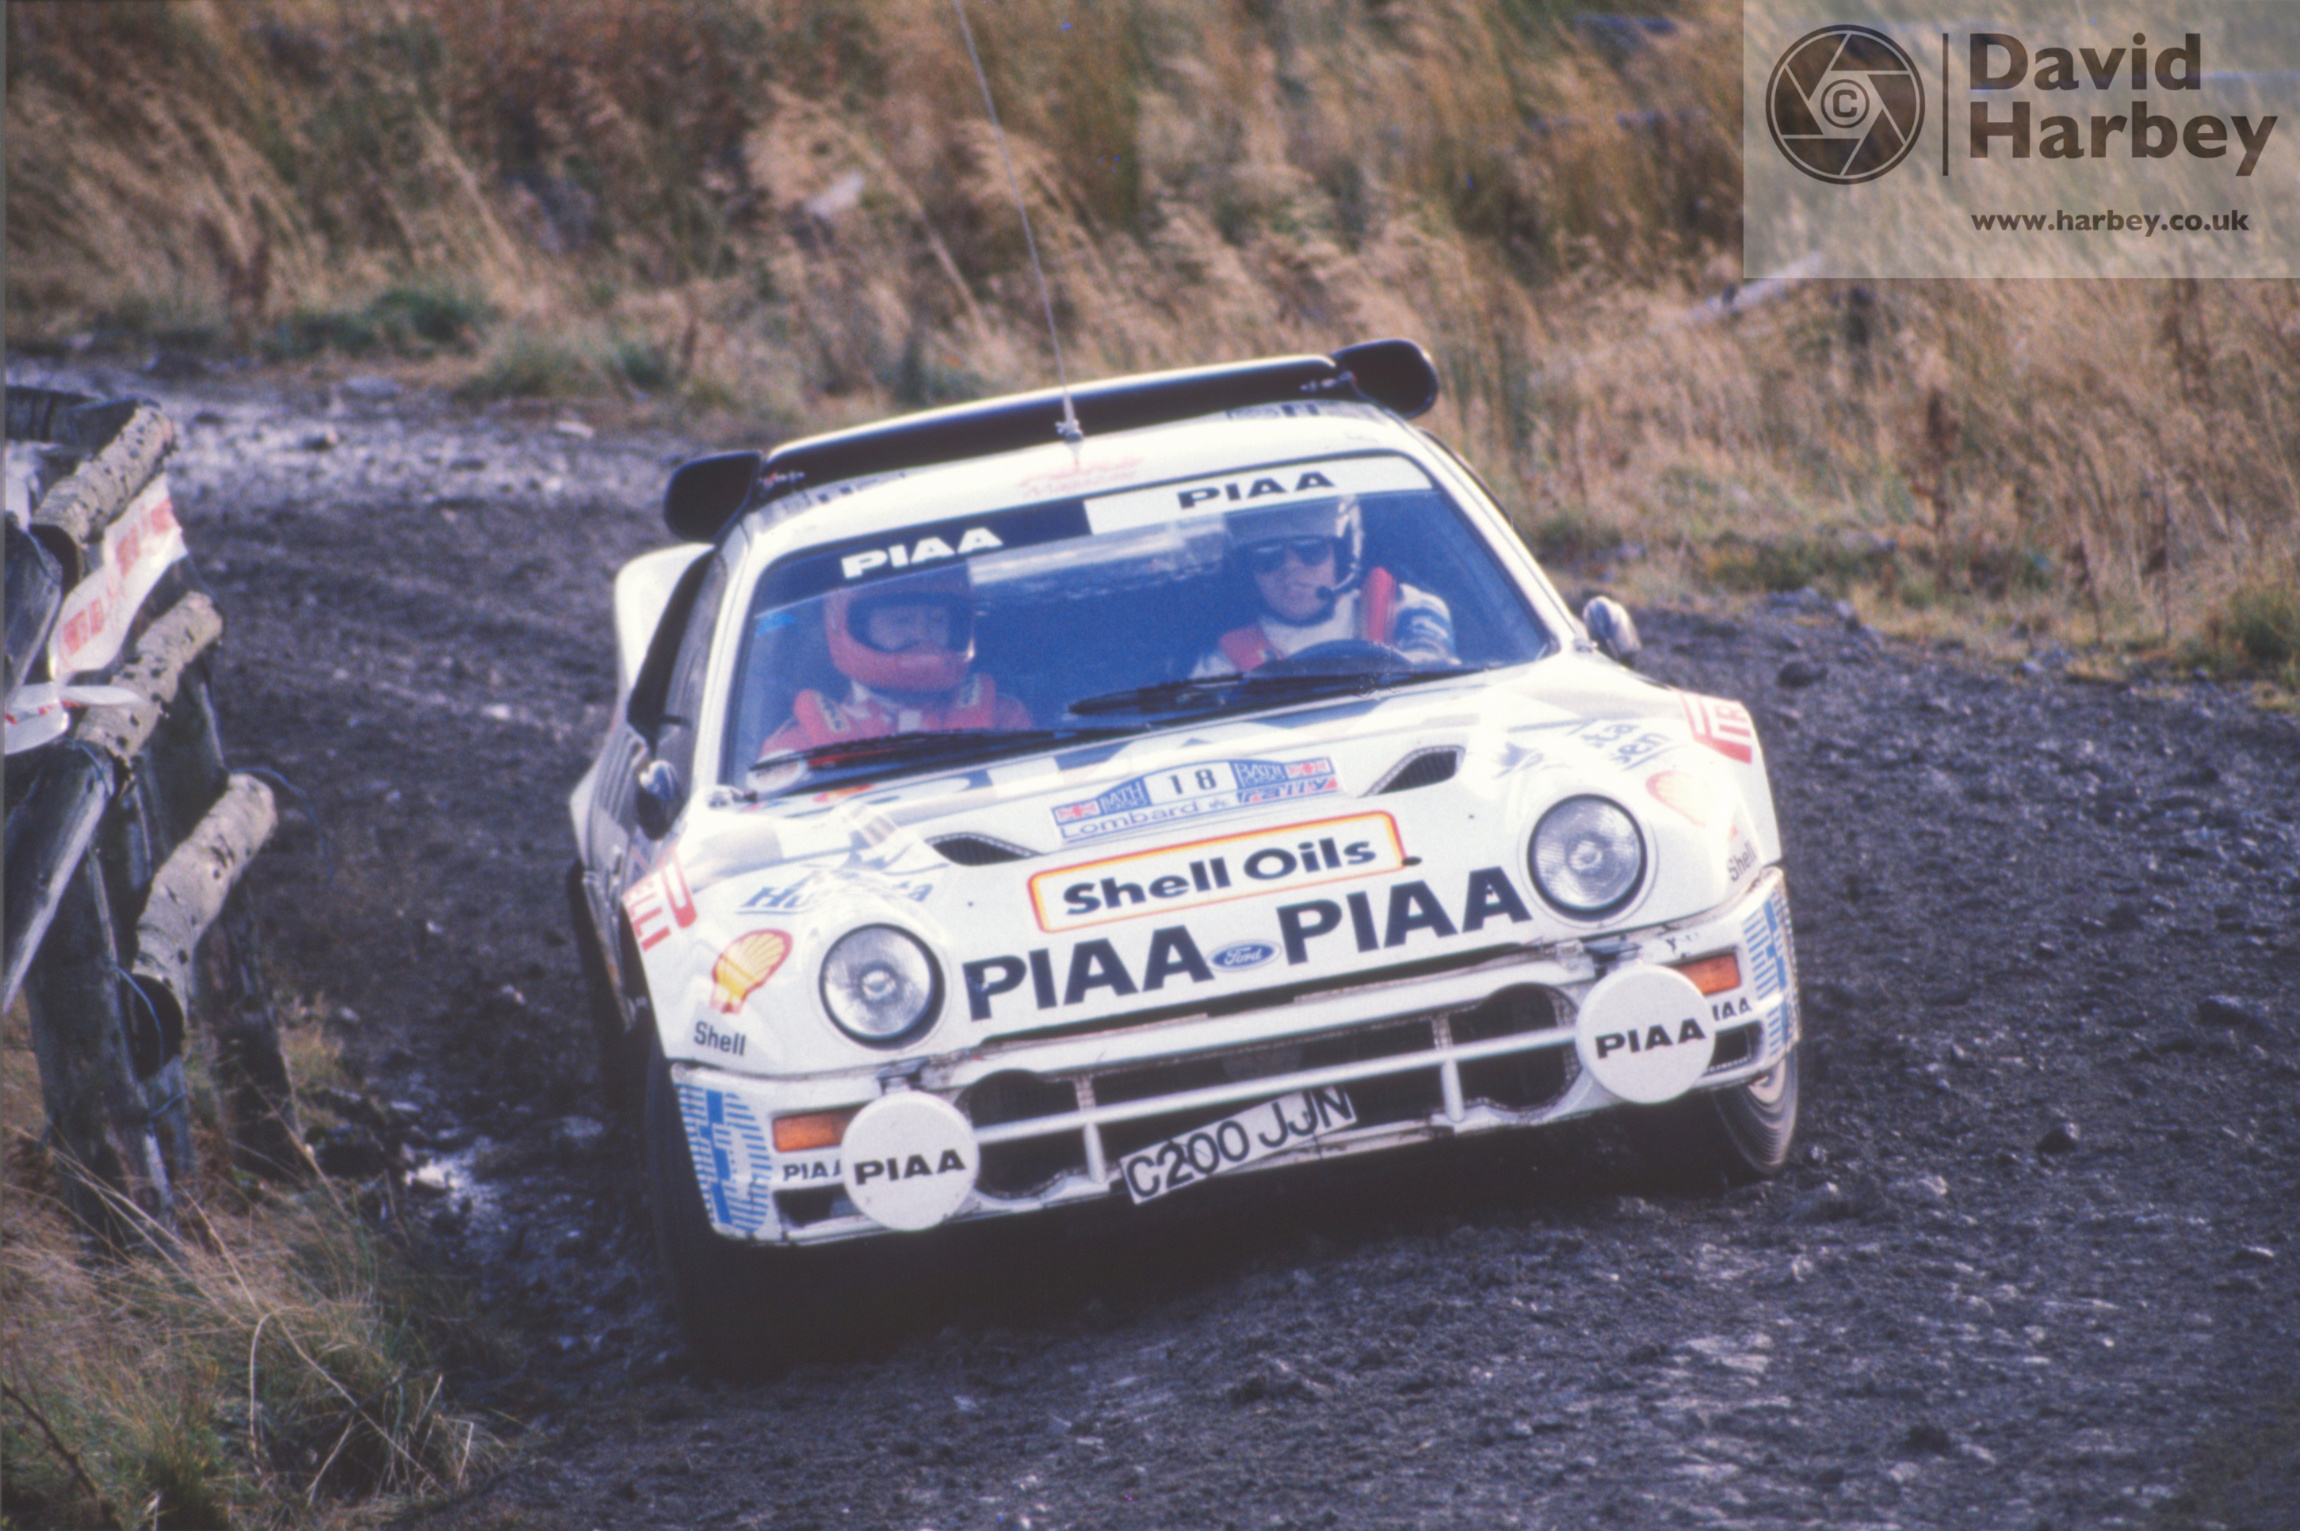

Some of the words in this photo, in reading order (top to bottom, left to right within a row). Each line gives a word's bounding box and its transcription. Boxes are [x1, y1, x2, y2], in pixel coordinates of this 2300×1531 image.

[1178, 470, 1333, 511] PIAA
[841, 526, 1003, 579] PIAA
[1168, 768, 1218, 795] 18
[1060, 800, 1200, 839] Lombard
[1063, 855, 1232, 915] Shell
[1243, 837, 1377, 881] Oils
[1726, 842, 1757, 882] Shell
[1276, 866, 1533, 966] PIAA
[962, 925, 1216, 1022] PIAA
[1223, 945, 1264, 966] Ford
[1711, 997, 1752, 1022] IAA
[693, 1021, 746, 1056] Shell
[1595, 1018, 1707, 1060] PIAA
[1126, 1119, 1250, 1198] C200
[1257, 1085, 1354, 1149] JJN
[853, 1148, 967, 1186] PIAA
